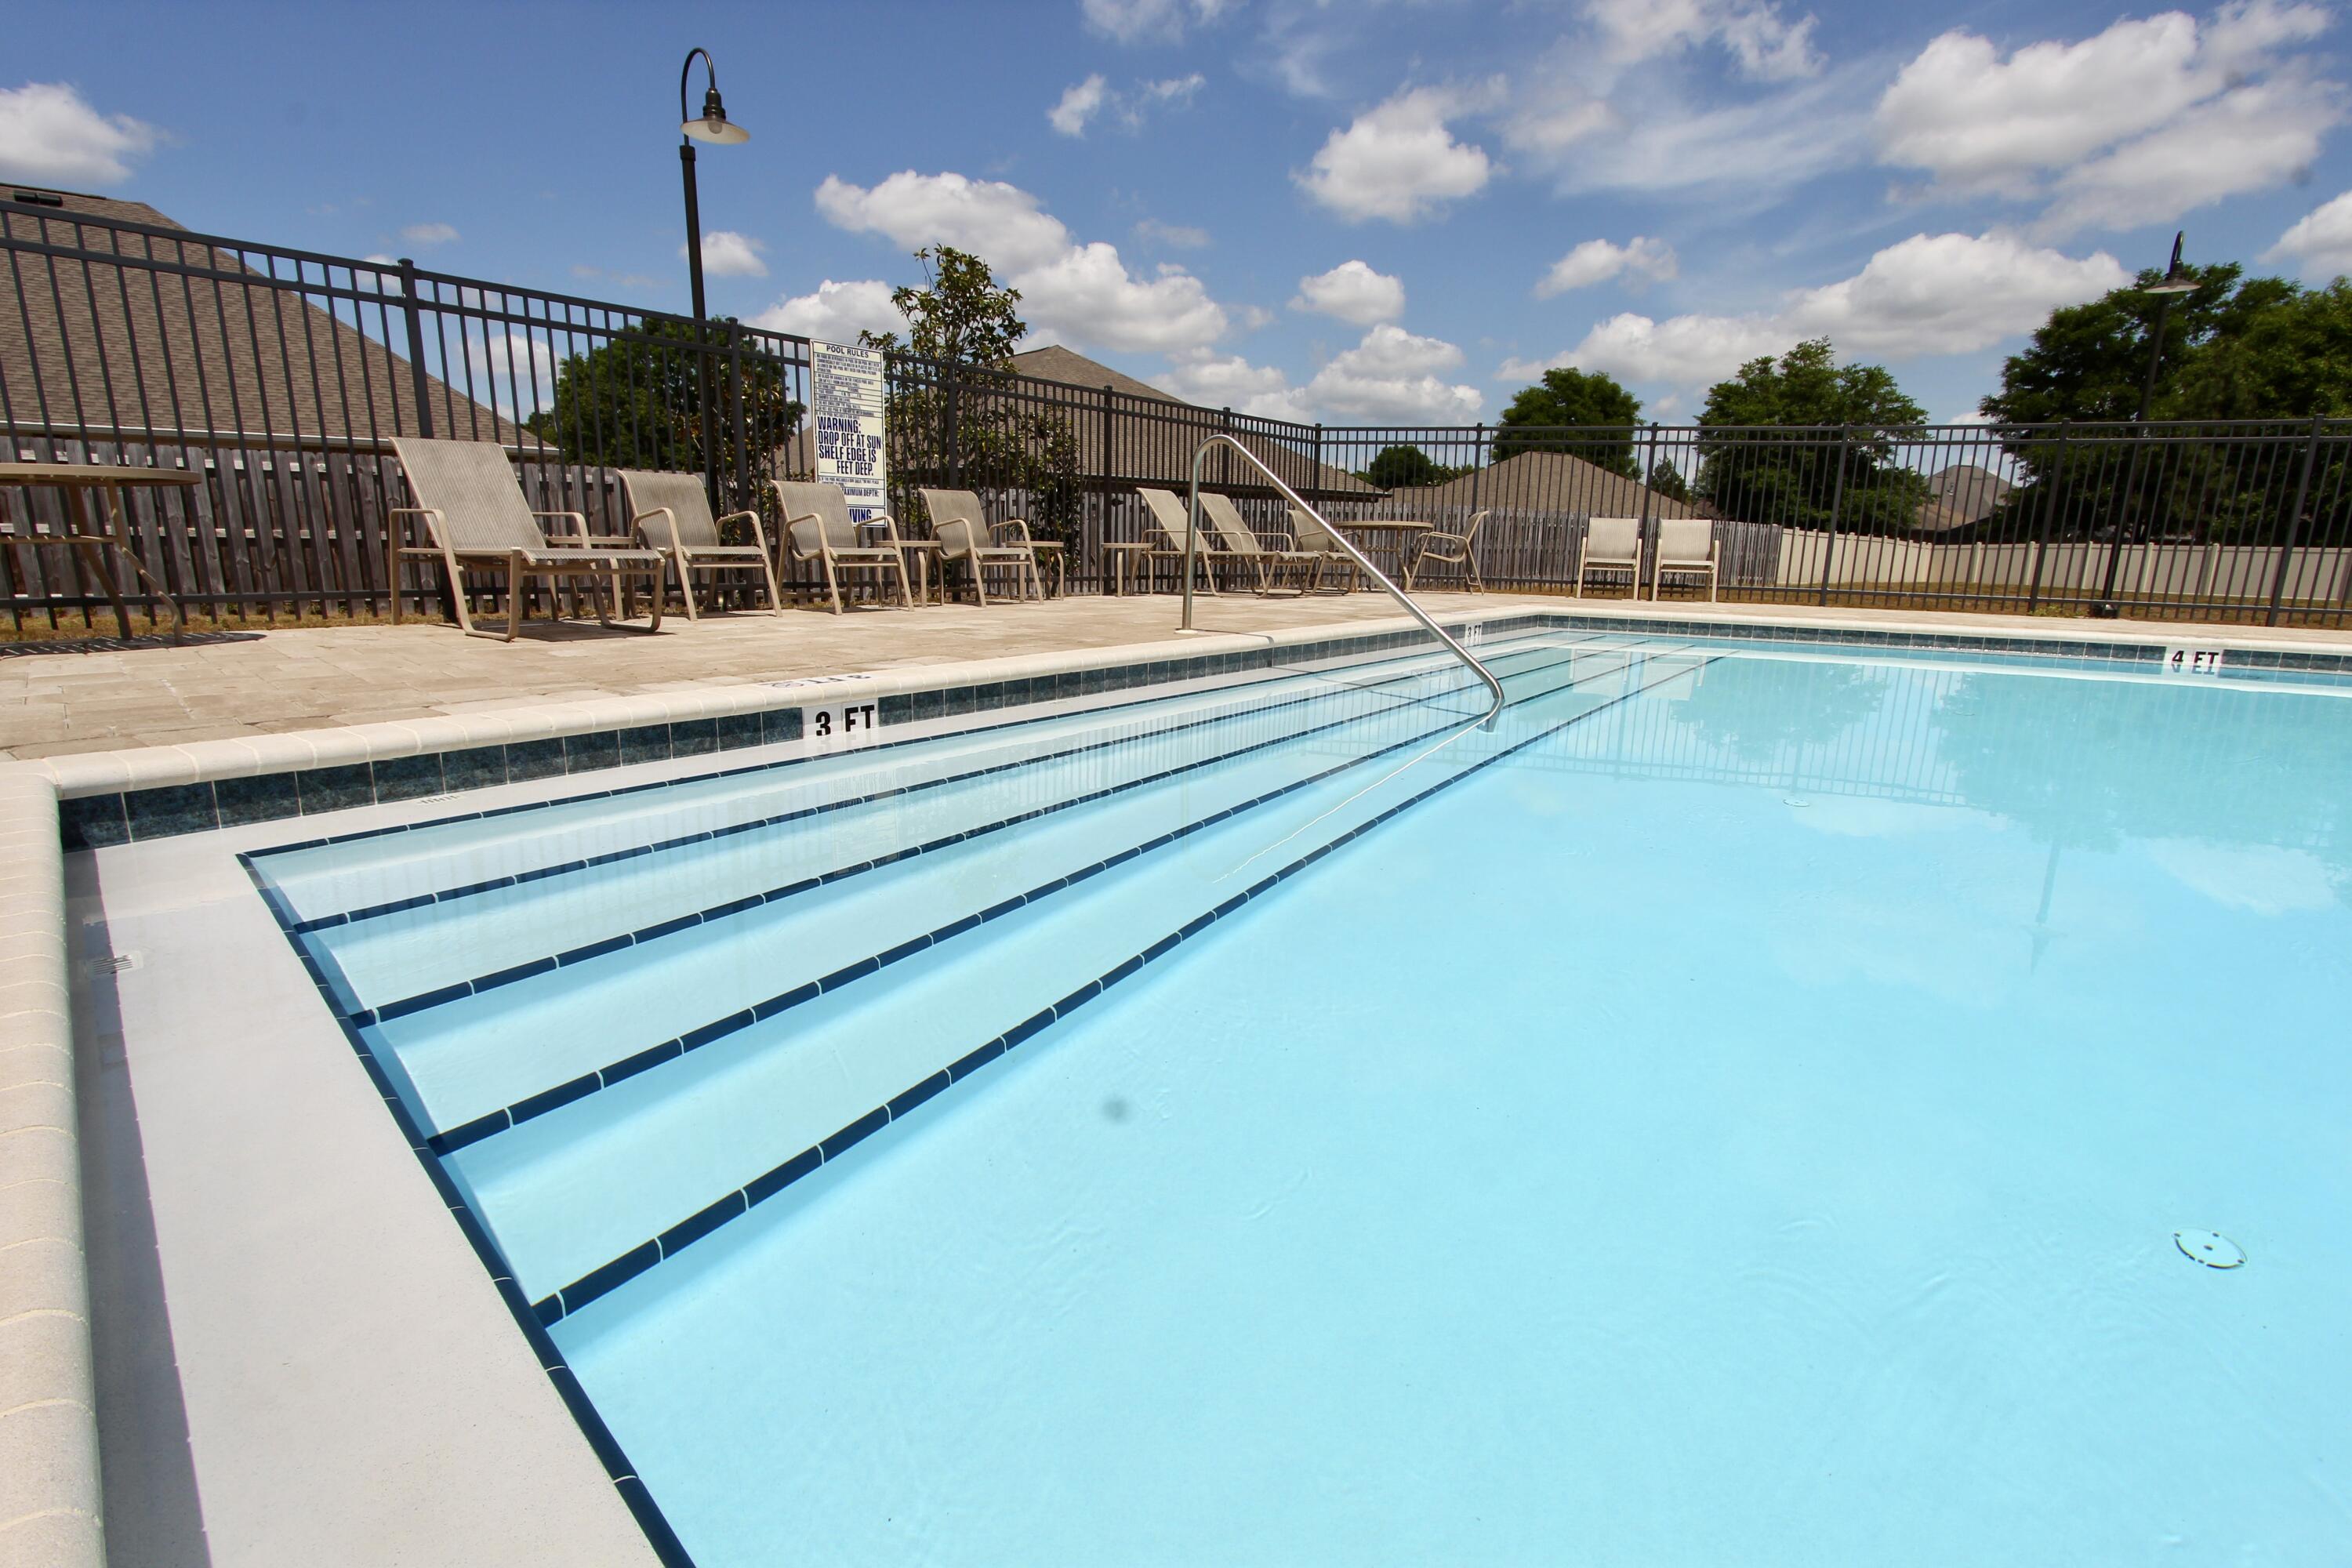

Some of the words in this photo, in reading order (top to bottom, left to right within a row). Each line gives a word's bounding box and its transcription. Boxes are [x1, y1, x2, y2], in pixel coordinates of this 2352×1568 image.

[826, 345, 844, 354] POOL
[847, 348, 869, 358] RULES
[817, 416, 861, 434] WARNING:
[818, 430, 839, 445] DROP
[841, 432, 855, 447] OFF
[856, 434, 865, 448] AT
[866, 434, 881, 450] SUN
[818, 445, 844, 460] SHELF
[847, 447, 866, 463] EDGE
[869, 448, 877, 463] IS
[837, 460, 854, 474] FEET
[855, 461, 874, 477] DEEP.
[849, 508, 872, 523] IVING
[1468, 626, 1472, 638] 3
[1474, 625, 1482, 637] FT
[2172, 650, 2184, 662] 4
[2194, 652, 2219, 664] FT
[815, 711, 831, 737] 3
[844, 704, 875, 733] FT
